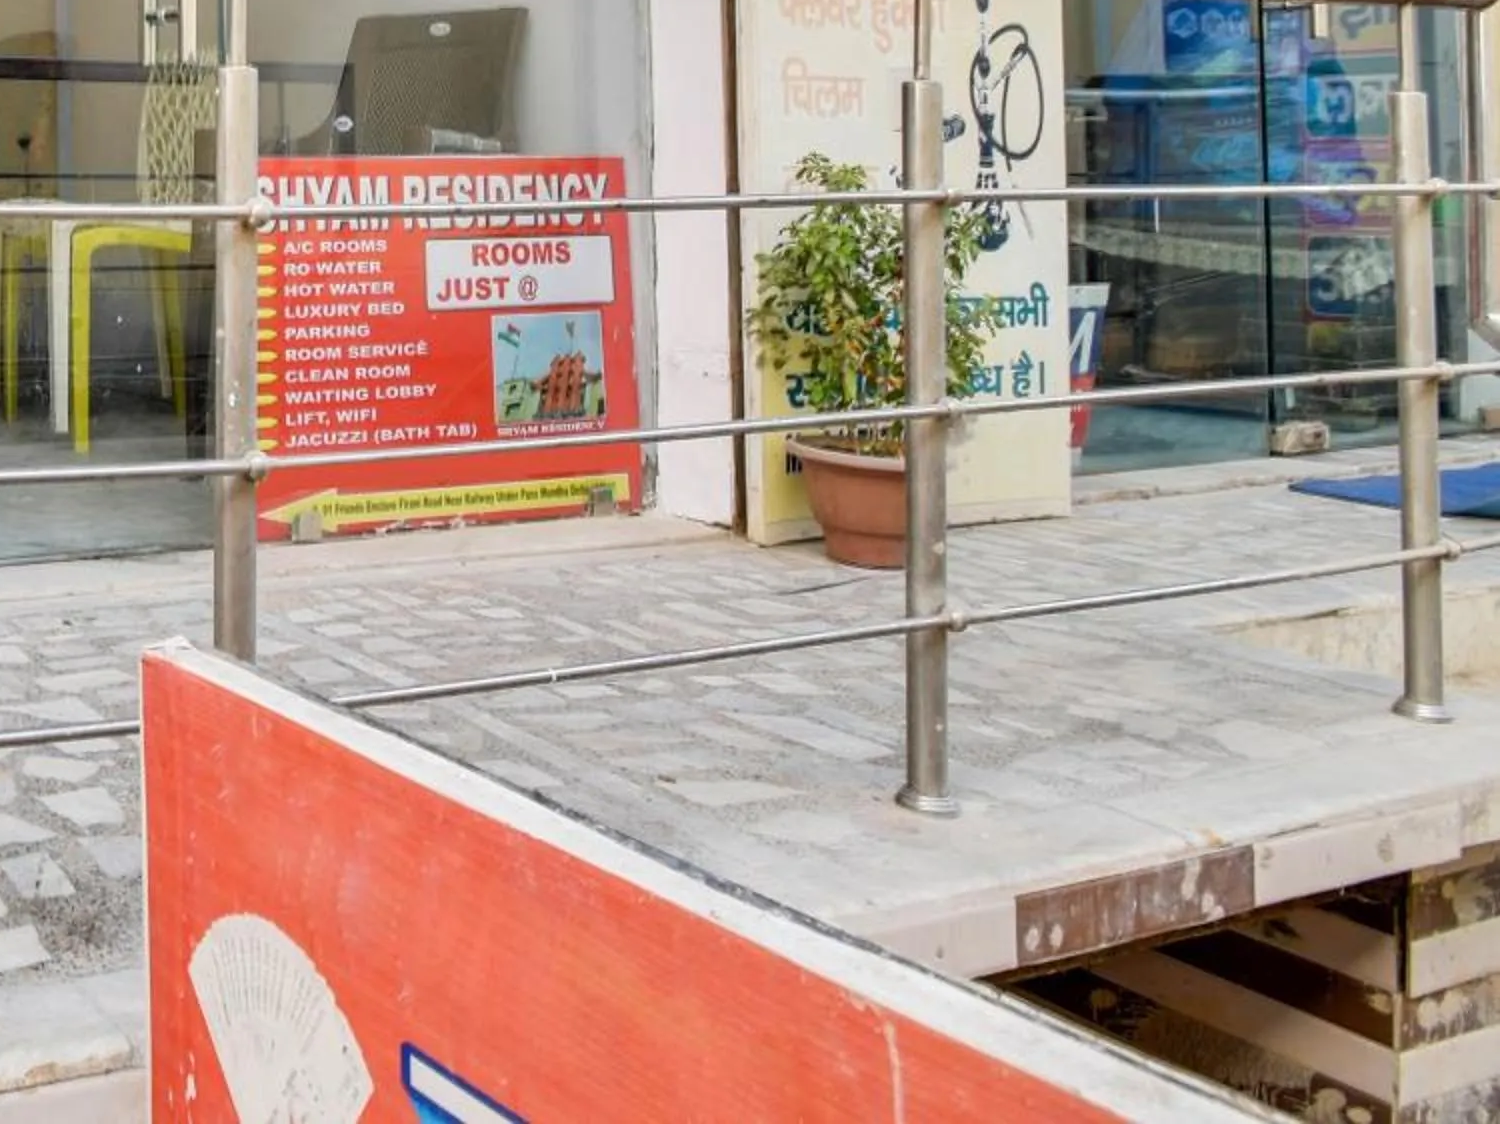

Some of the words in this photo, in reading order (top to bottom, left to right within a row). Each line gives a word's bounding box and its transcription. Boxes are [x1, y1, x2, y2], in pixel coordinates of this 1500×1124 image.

[403, 172, 607, 230] RESIDENCY
[320, 239, 388, 253] ROOMS
[471, 240, 571, 267] ROOMS
[283, 263, 310, 277] RO
[316, 261, 382, 274] WATER
[283, 283, 325, 297] HOT
[329, 281, 396, 296] WATER
[436, 277, 511, 302] JUST
[518, 275, 540, 302] @
[284, 304, 361, 319] LUXURY
[367, 302, 405, 316] BED
[284, 324, 371, 341] PARKING
[285, 347, 342, 362] ROOM
[348, 342, 429, 359] SERVICE
[285, 368, 349, 383] CLEAN
[355, 364, 411, 380] ROOM
[285, 387, 369, 405] WAITING
[375, 384, 437, 400] LOBBY
[285, 411, 331, 427] LIFT,
[336, 408, 377, 423] WIFI
[285, 431, 368, 449] JACUZZI
[373, 427, 430, 445] (BATH
[436, 423, 478, 439] TAB)
